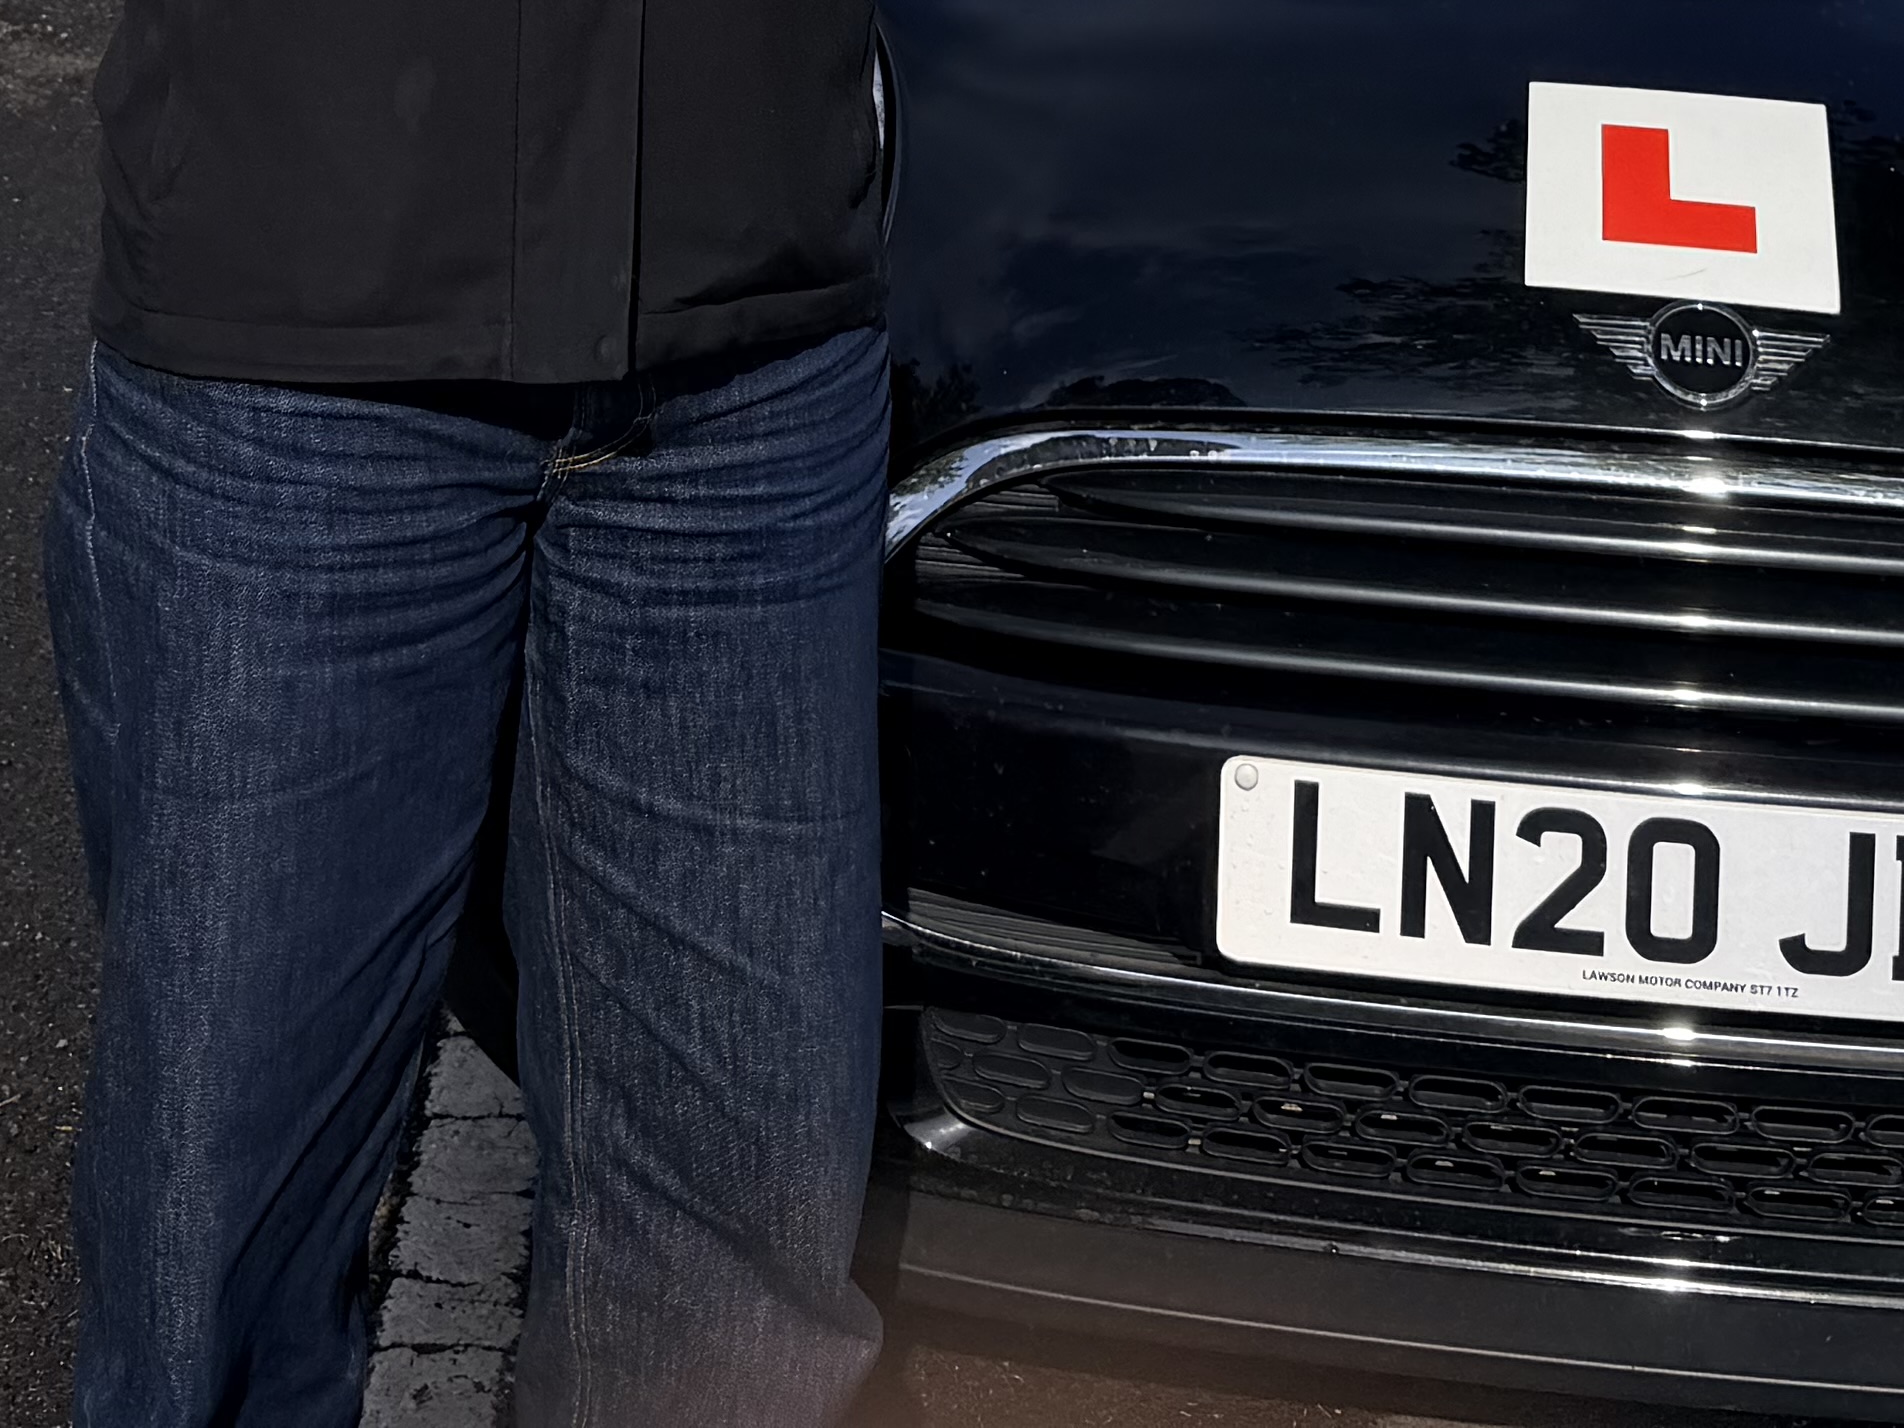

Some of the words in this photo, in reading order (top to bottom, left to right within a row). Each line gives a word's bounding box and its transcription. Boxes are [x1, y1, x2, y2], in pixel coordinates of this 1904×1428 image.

[1601, 124, 1757, 254] L
[1660, 332, 1743, 369] MINI
[1289, 778, 1721, 966] LN20
[1581, 969, 1636, 985] LAWSON
[1638, 974, 1682, 989] MOTOR
[1684, 978, 1747, 995] COMPANY
[1749, 983, 1772, 996] ST7
[1775, 986, 1800, 998] 1TZ
